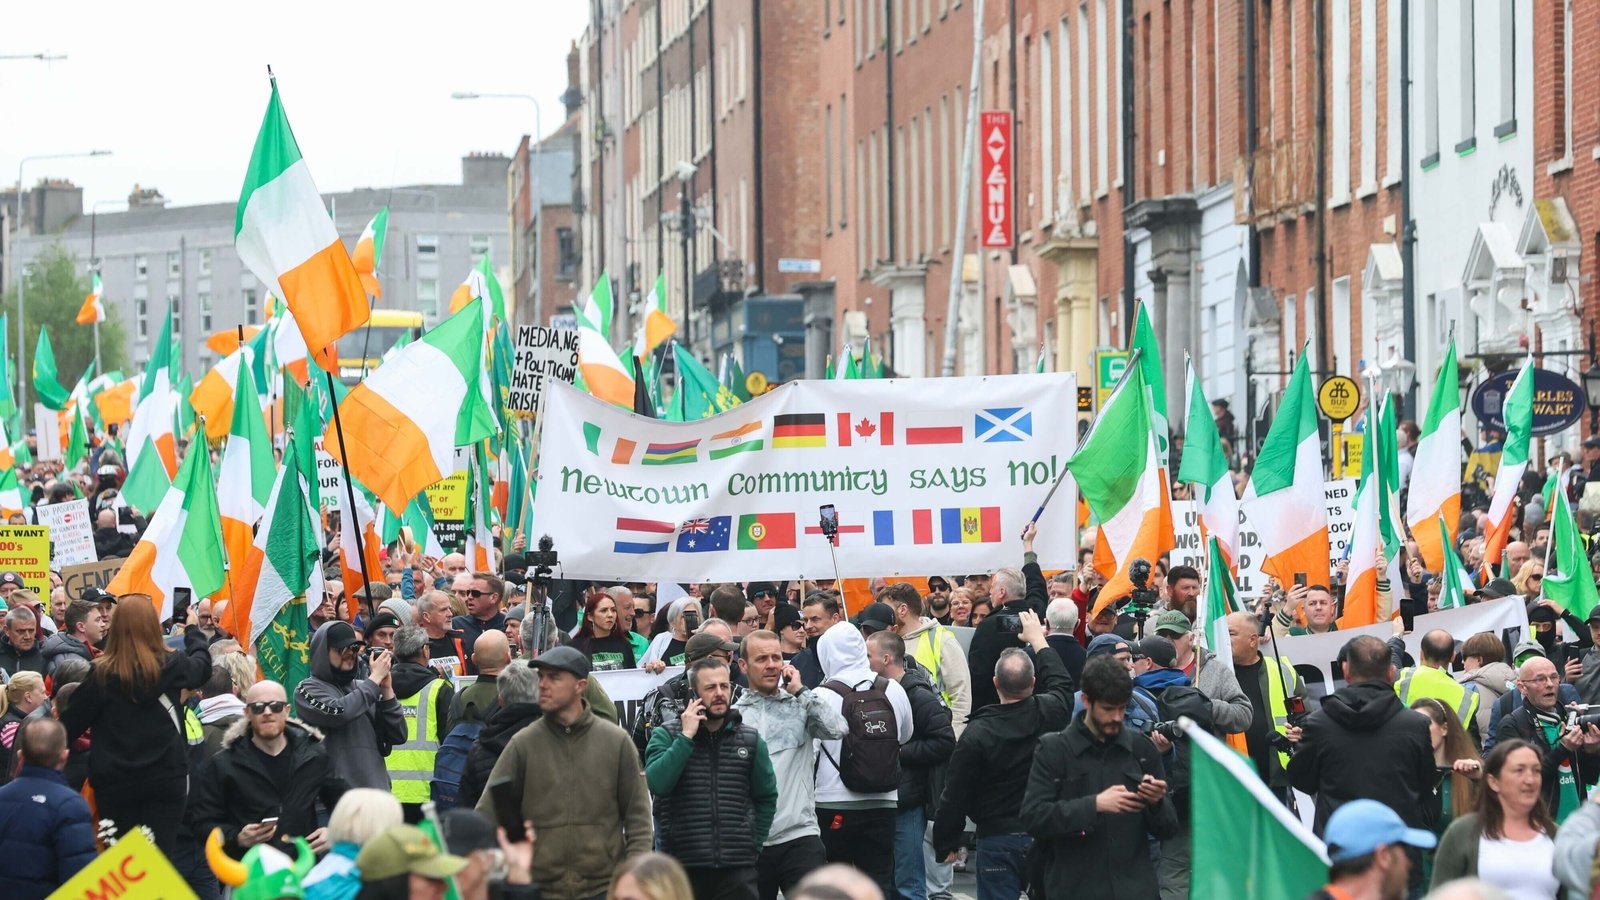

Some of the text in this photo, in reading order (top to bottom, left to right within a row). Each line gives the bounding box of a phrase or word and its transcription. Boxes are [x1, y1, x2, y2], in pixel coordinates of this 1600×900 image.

[986, 126, 1007, 245] AVENUE
[512, 370, 543, 391] HATE
[507, 391, 539, 412] IRISH
[1533, 390, 1574, 402] RLES
[317, 459, 339, 469] FOR
[561, 465, 709, 504] Newtown
[728, 465, 888, 496] Community
[440, 533, 456, 543] yet!
